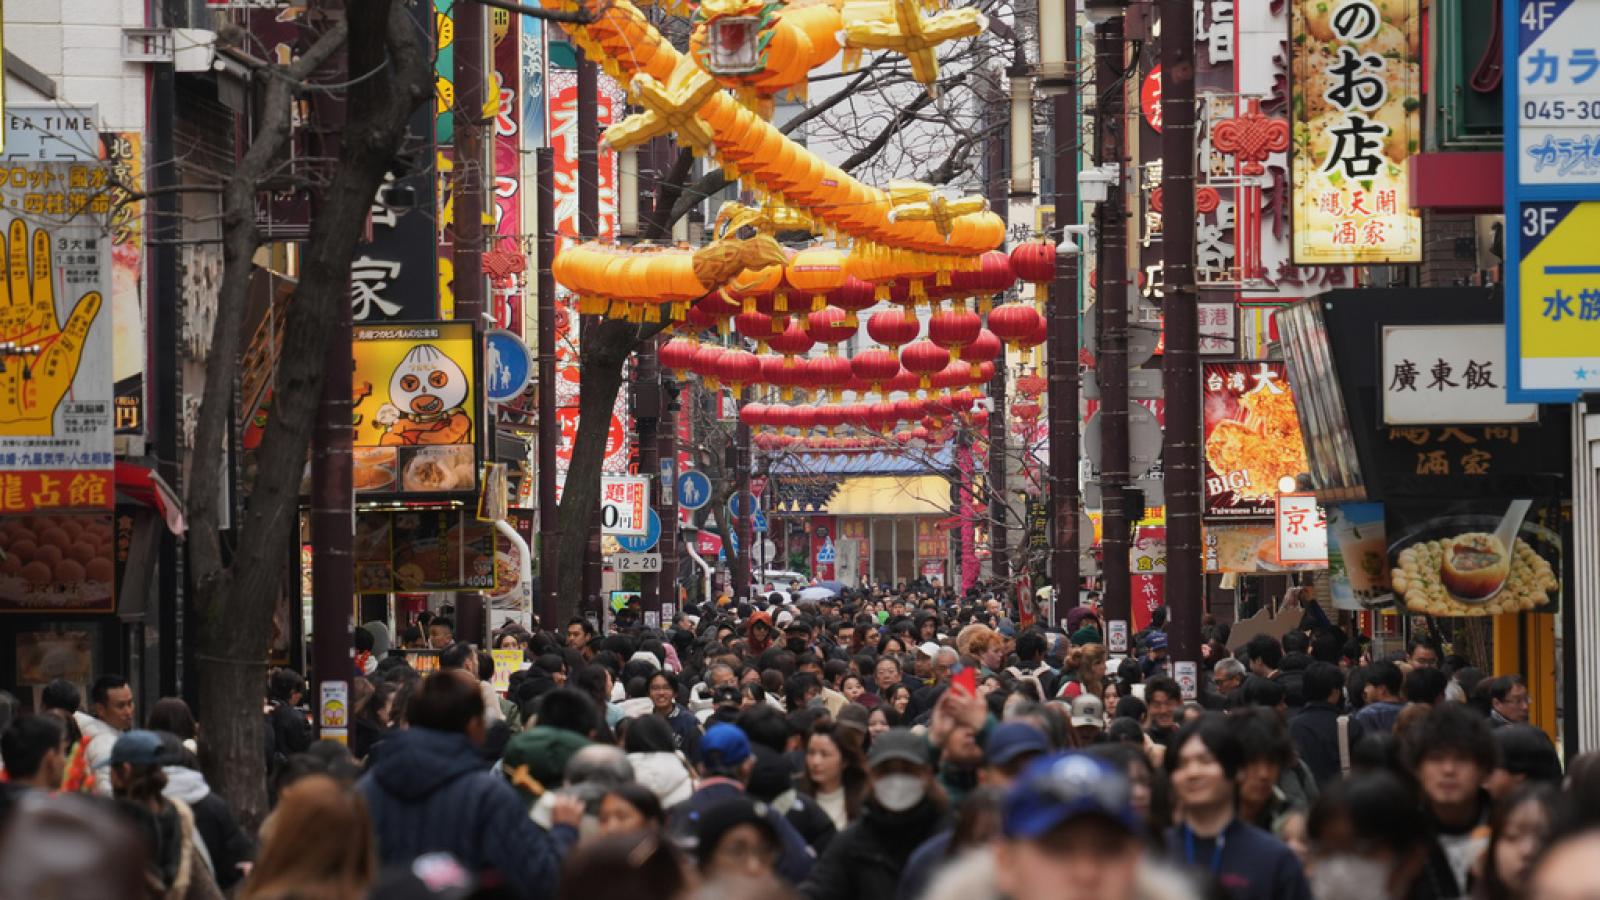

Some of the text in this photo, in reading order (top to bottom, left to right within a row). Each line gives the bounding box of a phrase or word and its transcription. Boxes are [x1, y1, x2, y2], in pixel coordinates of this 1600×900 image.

[1521, 2, 1556, 31] 4F
[1525, 48, 1600, 85] カラ
[1324, 2, 1385, 179] のお店
[44, 117, 92, 130] TIME
[1524, 101, 1600, 120] 045-30
[1527, 135, 1600, 176] カラオ
[1332, 221, 1387, 246] 酒家
[1523, 207, 1558, 237] 3F
[1542, 288, 1600, 321] 水族
[1207, 372, 1245, 392] 台湾
[1389, 358, 1504, 392] 廣東飯
[1207, 469, 1252, 497] BIG!
[1210, 507, 1251, 515] Taiwanese
[1283, 506, 1310, 535] 京
[618, 558, 657, 569] 12-20
